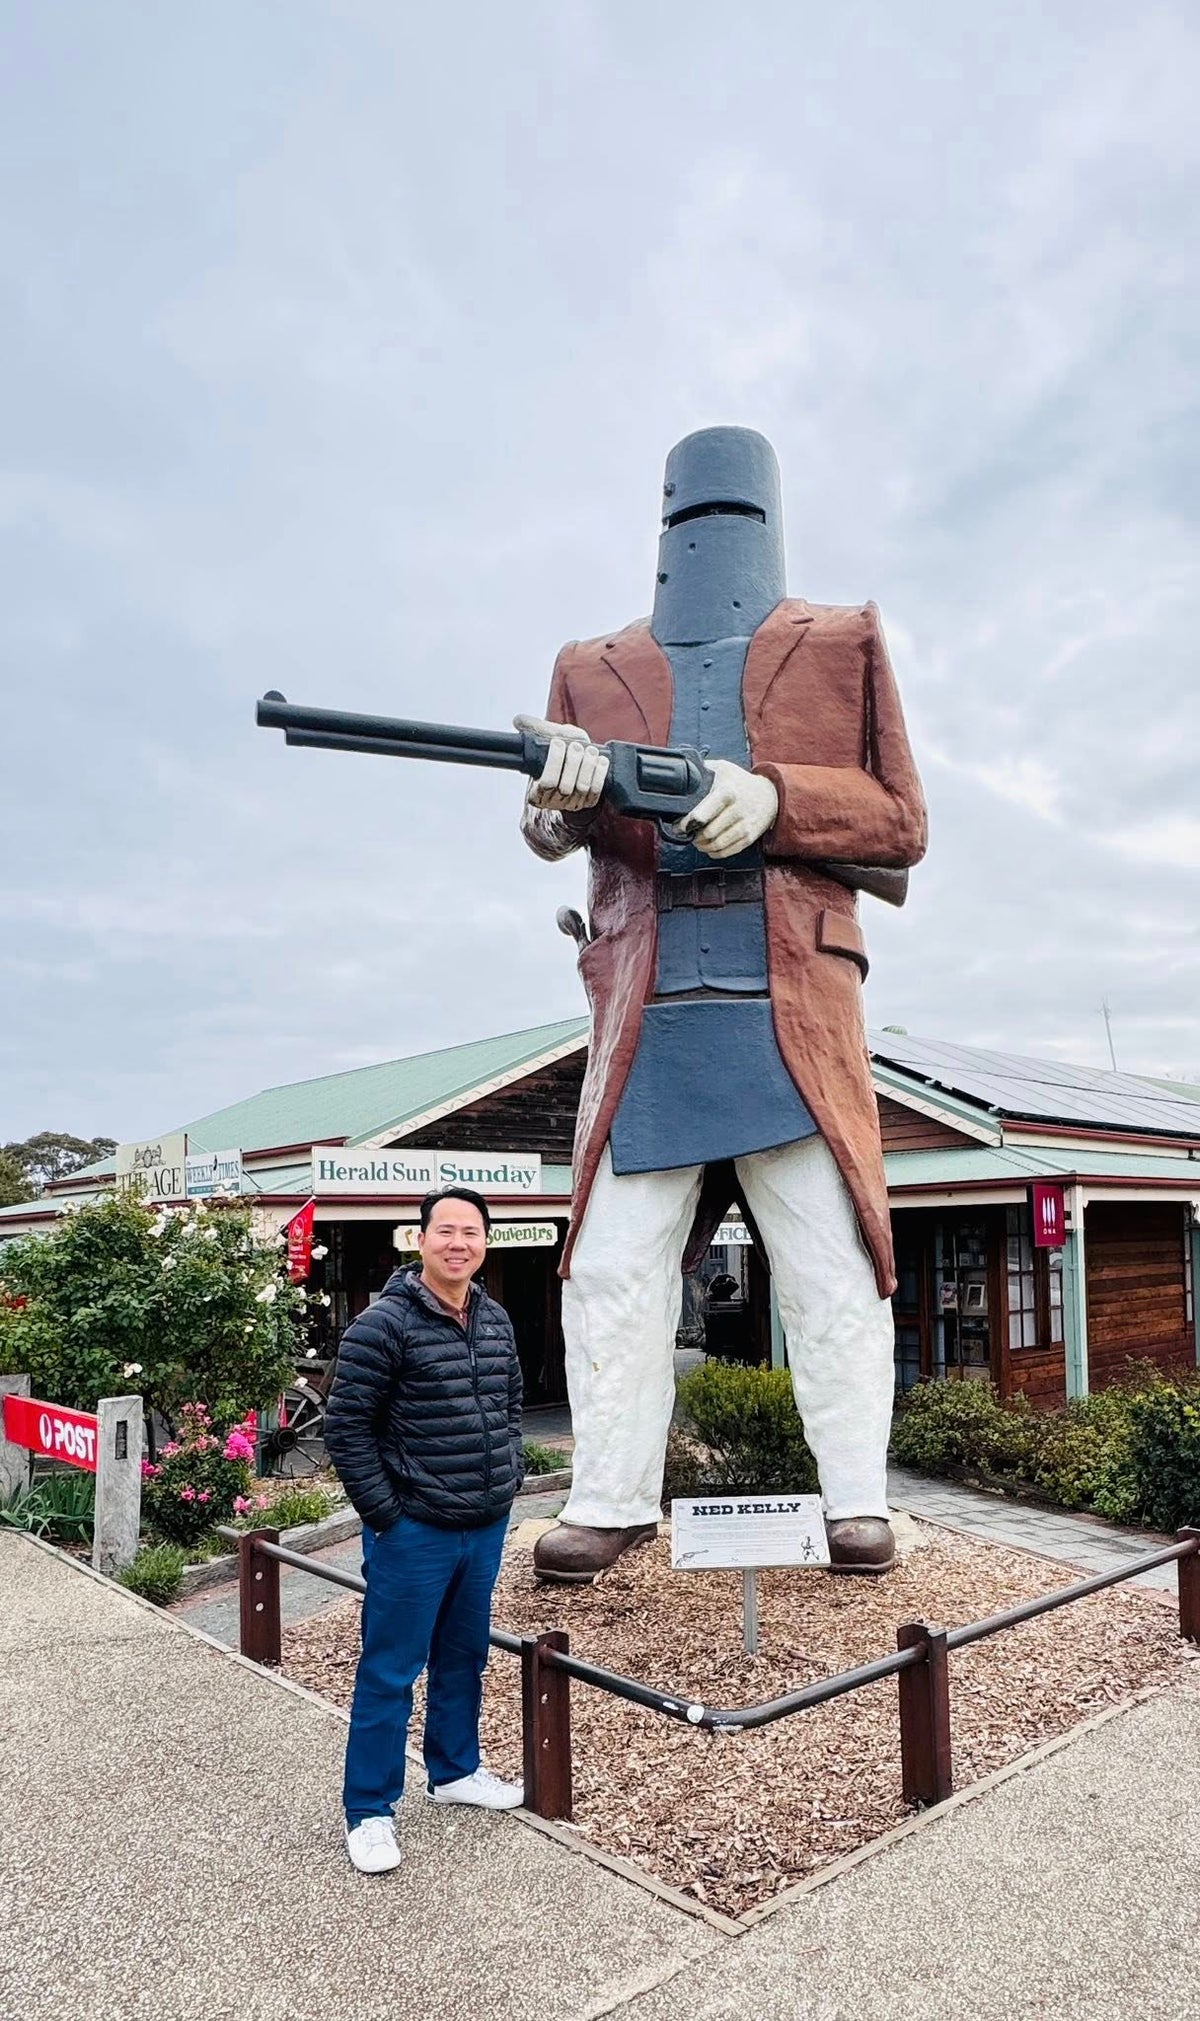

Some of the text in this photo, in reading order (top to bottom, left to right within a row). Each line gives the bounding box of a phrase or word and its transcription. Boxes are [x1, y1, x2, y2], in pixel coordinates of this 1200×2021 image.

[150, 1167, 182, 1196] AGE
[218, 1160, 240, 1180] TIMES
[318, 1159, 431, 1182] Herald Sun
[440, 1162, 537, 1189] Sunday
[53, 1418, 96, 1462] POST
[692, 1502, 801, 1516] NED KELLY
